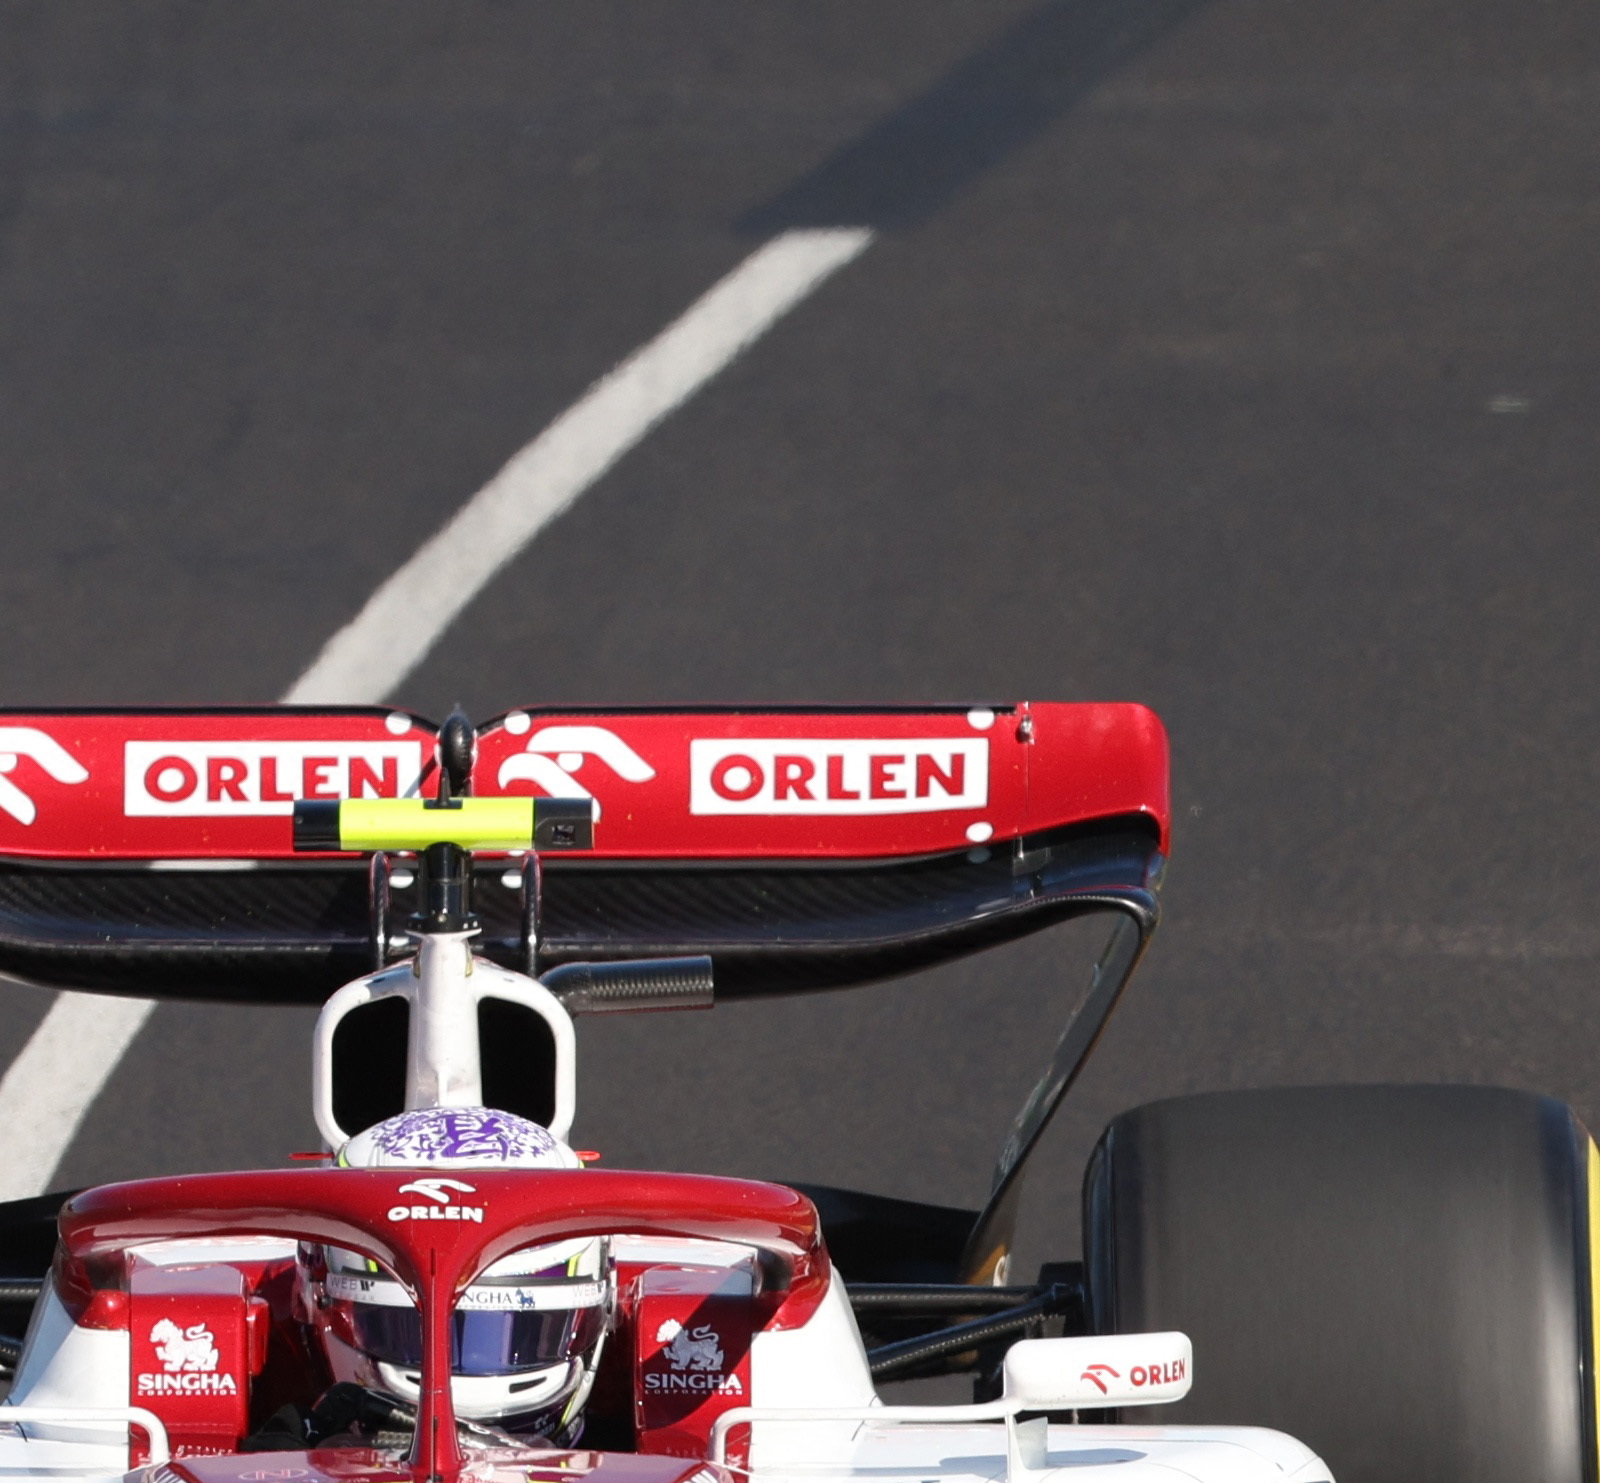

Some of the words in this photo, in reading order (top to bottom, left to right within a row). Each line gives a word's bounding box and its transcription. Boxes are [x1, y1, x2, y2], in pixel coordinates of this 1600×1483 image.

[143, 756, 398, 801] ORLEN
[710, 752, 966, 802] ORLEN
[388, 1206, 483, 1222] ORLEN
[460, 1291, 513, 1304] NGHA
[1130, 1358, 1185, 1387] ORLEN
[138, 1373, 236, 1389] SINGHA
[645, 1373, 742, 1389] SINGHA
